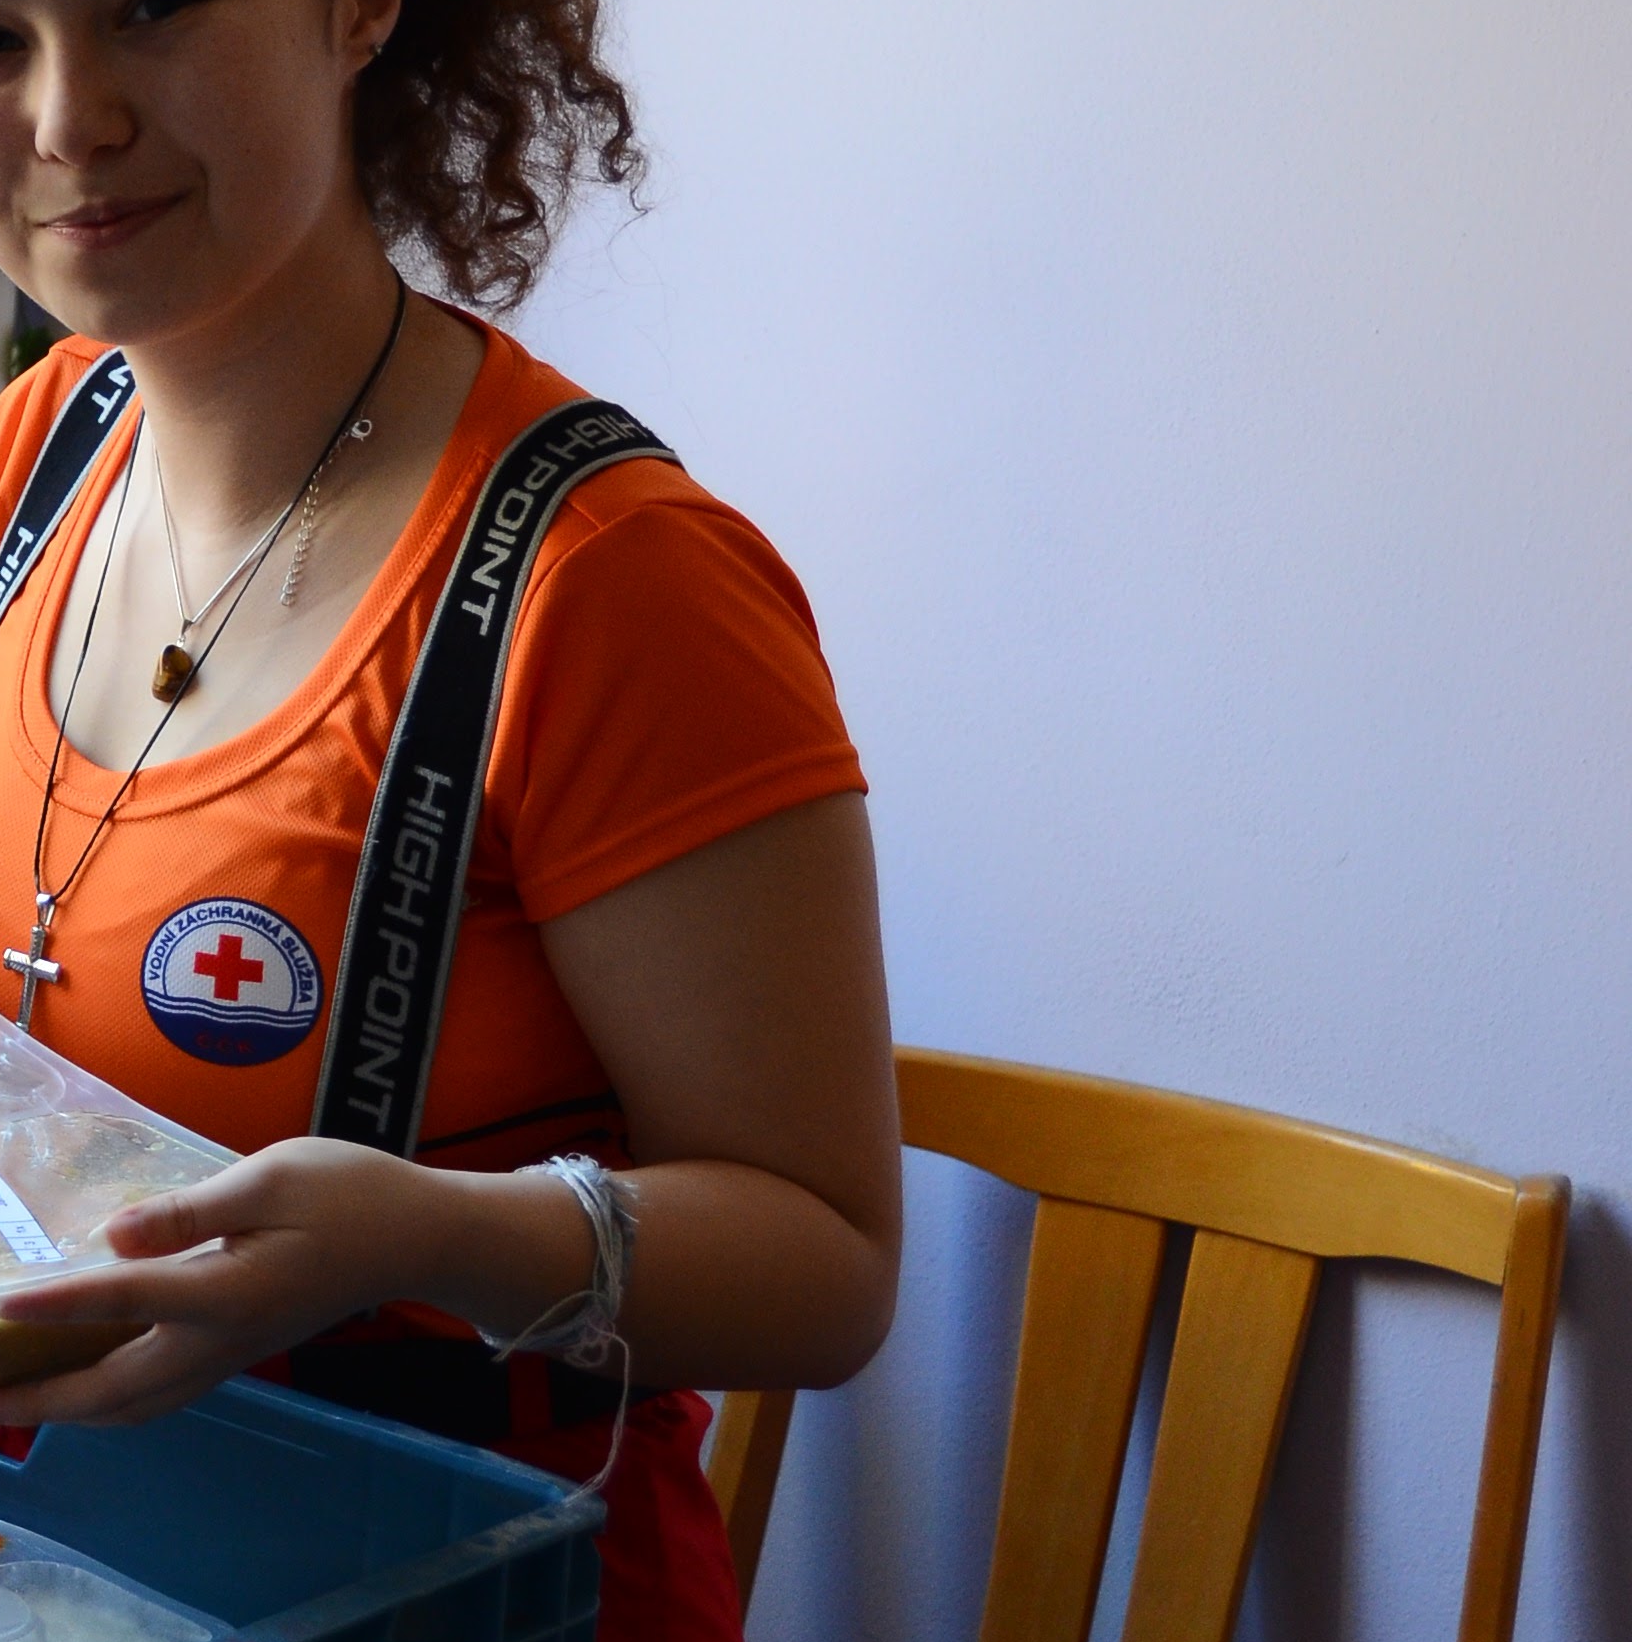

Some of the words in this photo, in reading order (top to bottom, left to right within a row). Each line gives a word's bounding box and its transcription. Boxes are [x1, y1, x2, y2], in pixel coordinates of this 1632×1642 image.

[545, 413, 649, 461] HIGH
[461, 455, 559, 637] POINT
[382, 764, 453, 927] HIGH
[149, 928, 176, 981] VODNÍ
[174, 906, 283, 938] ZÁCHRANNÁ
[281, 936, 315, 1004] SLUŽBA
[347, 927, 419, 1135] POINT
